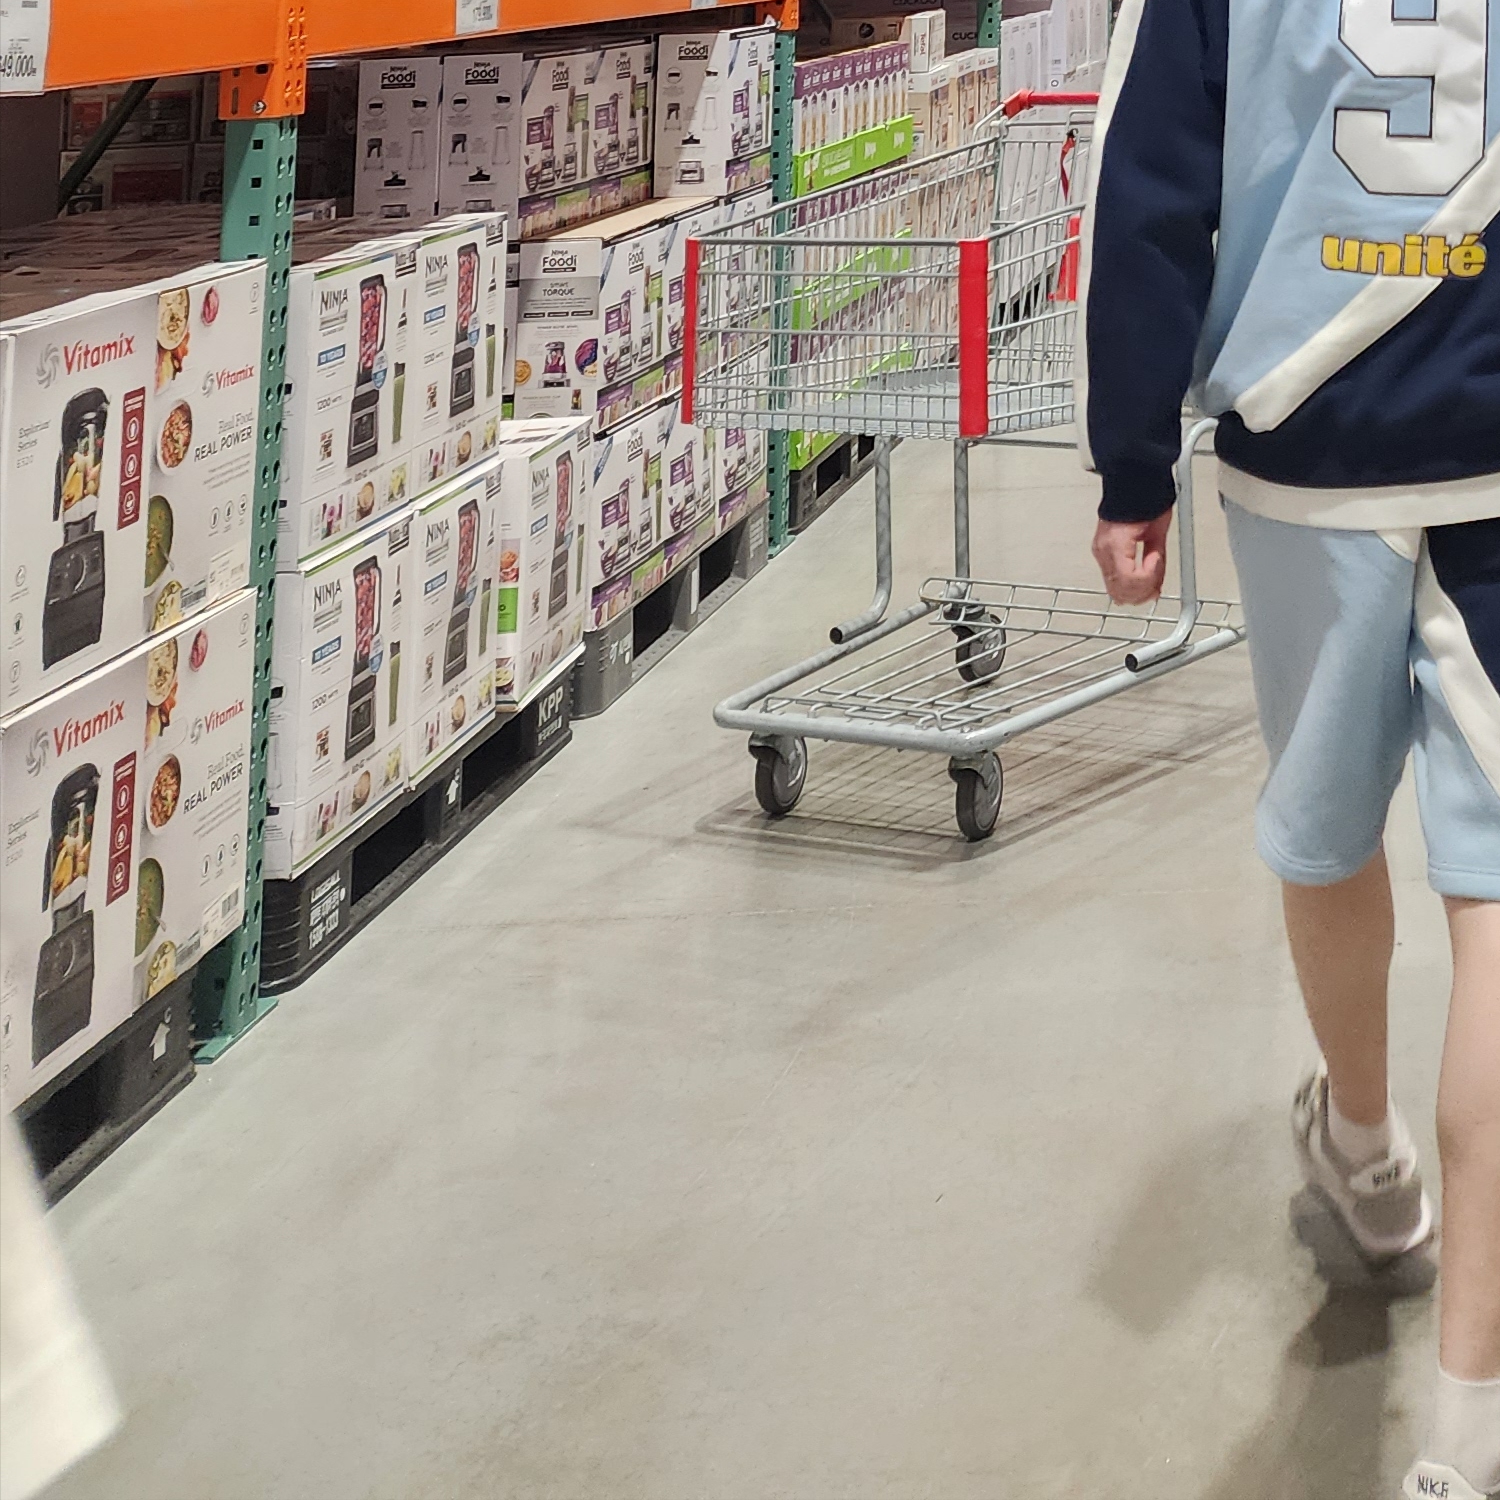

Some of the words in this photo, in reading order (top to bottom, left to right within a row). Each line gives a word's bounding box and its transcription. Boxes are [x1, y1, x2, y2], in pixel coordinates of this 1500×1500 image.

[678, 45, 709, 57] Foodi
[381, 70, 417, 83] Foodi
[465, 67, 500, 79] Foodi
[425, 254, 448, 278] NINJA
[542, 255, 578, 268] Foodi
[628, 248, 645, 267] Foodi
[1320, 231, 1488, 278] unité
[319, 288, 348, 315] NINJA
[542, 288, 575, 297] TORQUE
[63, 332, 135, 375] Vitamix
[216, 364, 255, 390] Vitamix
[194, 441, 218, 462] REAL
[220, 426, 252, 451] POWER
[426, 518, 450, 548] NINJA
[313, 578, 343, 613] NINJA
[321, 638, 340, 658] YEARS
[204, 699, 244, 734] Vitamix
[538, 686, 563, 727] KPP
[53, 700, 125, 758] Vitamix
[183, 787, 208, 814] REAL
[210, 762, 243, 797] POWER
